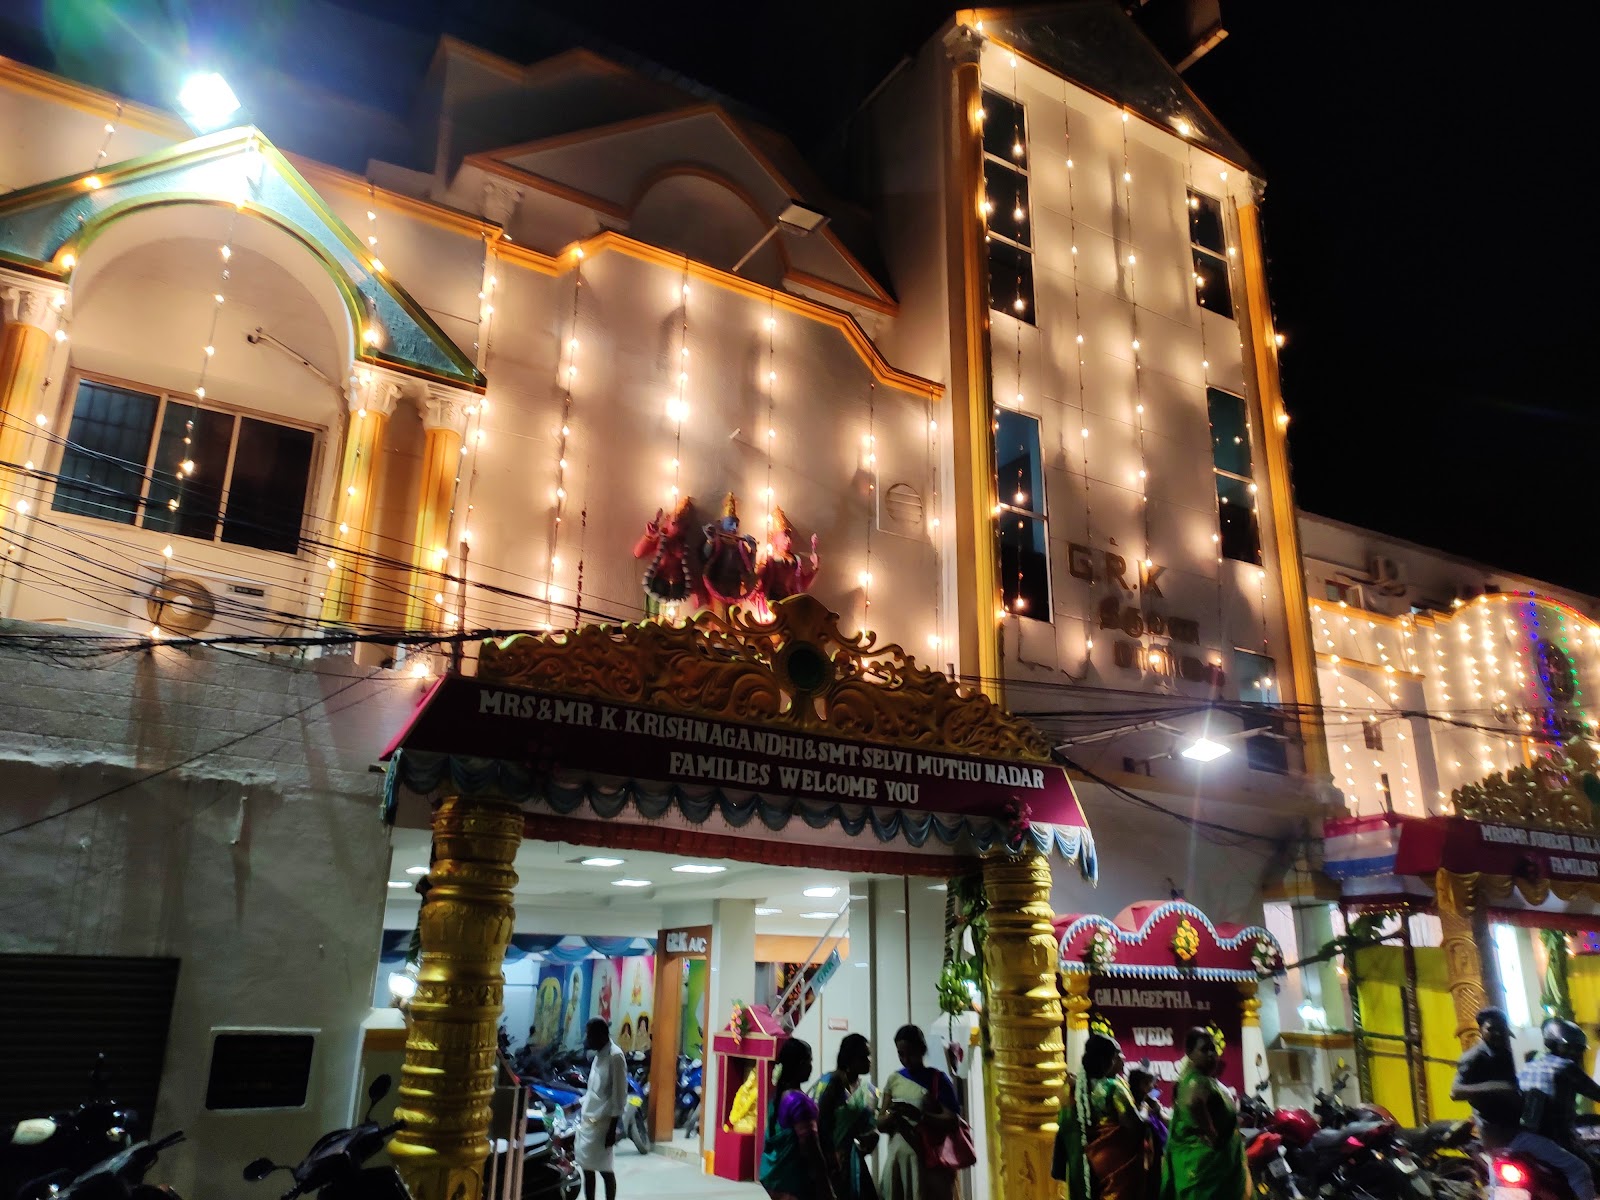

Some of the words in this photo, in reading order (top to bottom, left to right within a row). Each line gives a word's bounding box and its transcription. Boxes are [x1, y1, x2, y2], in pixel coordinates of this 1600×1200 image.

[669, 751, 771, 786] FAMILIES
[778, 765, 878, 799] WELCOME
[884, 780, 919, 804] YOU
[862, 747, 913, 774] SELVI
[916, 755, 982, 782] MUTHU
[984, 763, 1045, 789] NADAR
[1132, 1026, 1174, 1046] WEDS
